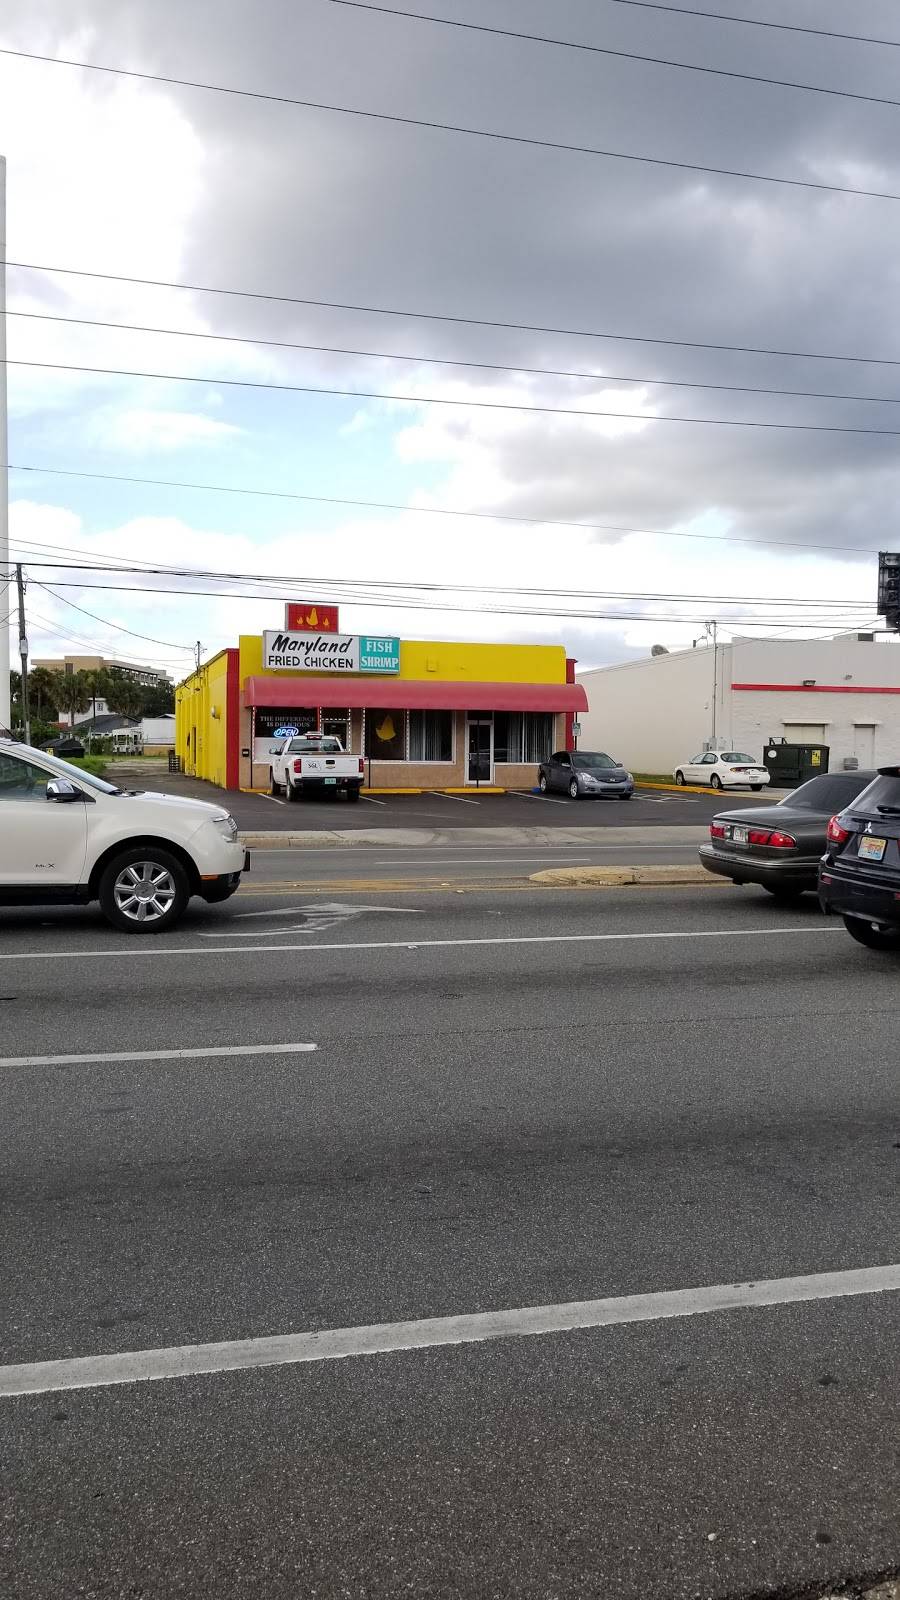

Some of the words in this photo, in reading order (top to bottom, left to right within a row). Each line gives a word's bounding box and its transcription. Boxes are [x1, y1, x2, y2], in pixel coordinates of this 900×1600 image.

[271, 634, 353, 656] Maryland
[366, 641, 393, 653] FISH
[268, 655, 300, 667] FRIED
[303, 656, 354, 669] CHICKEN
[361, 656, 399, 668] SHRIMP
